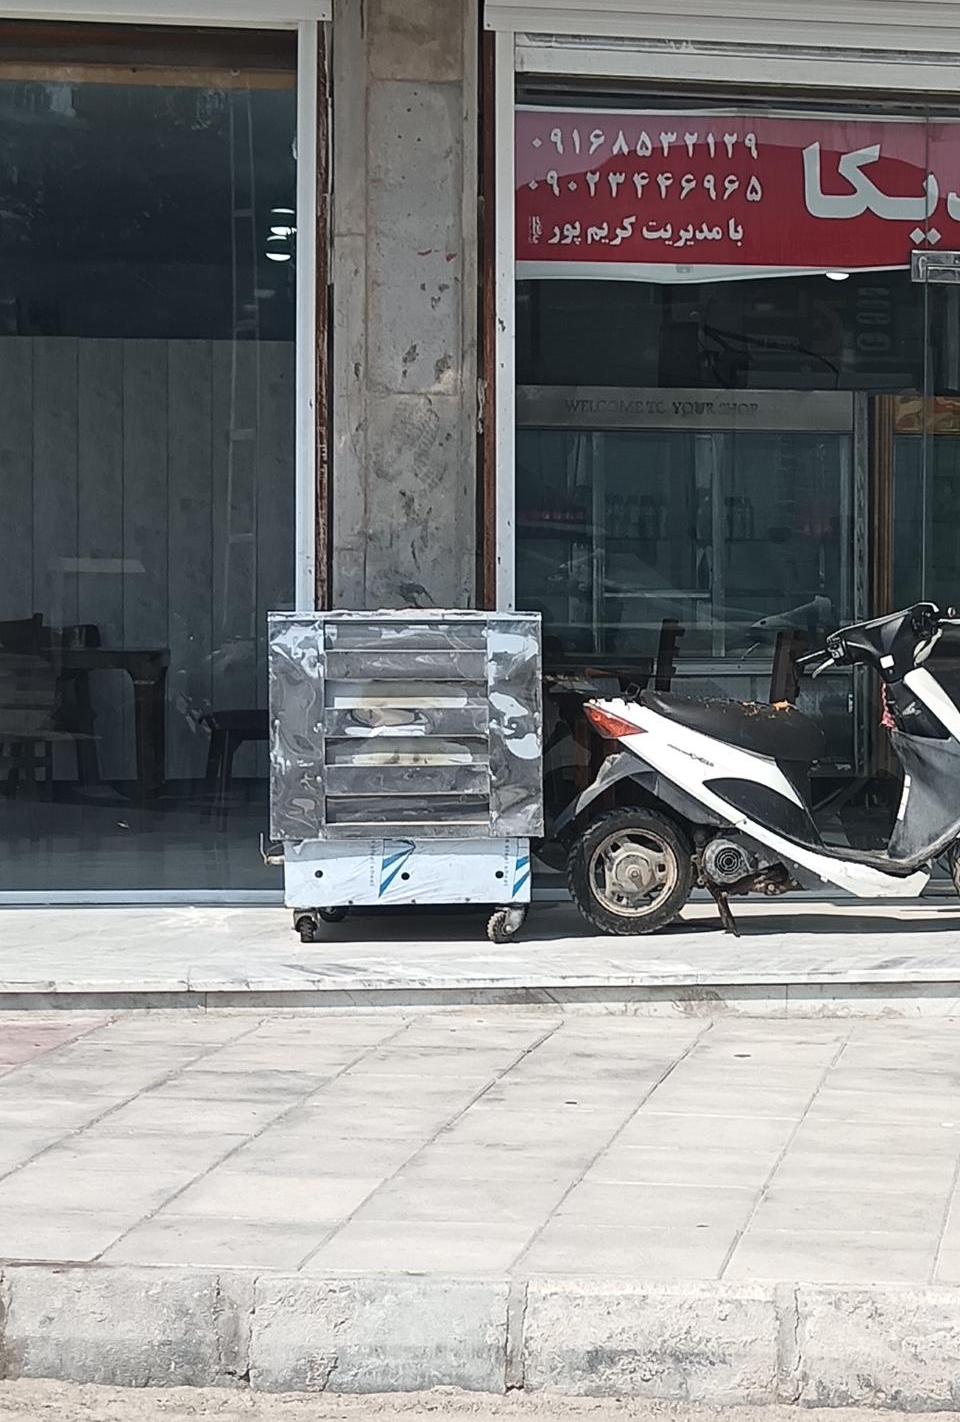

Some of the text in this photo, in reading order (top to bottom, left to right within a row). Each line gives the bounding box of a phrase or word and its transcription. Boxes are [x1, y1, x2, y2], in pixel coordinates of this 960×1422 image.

[531, 128, 758, 159] ۰۹۱۶۸۵۳۲۱۲۹
[528, 170, 762, 201] ۰۹۰۲۳۴۴۶۹۶۵
[547, 220, 582, 246] پور
[586, 215, 637, 246] کریم
[642, 220, 723, 248] مدیریت
[728, 217, 744, 247] با
[671, 401, 716, 415] YOUR
